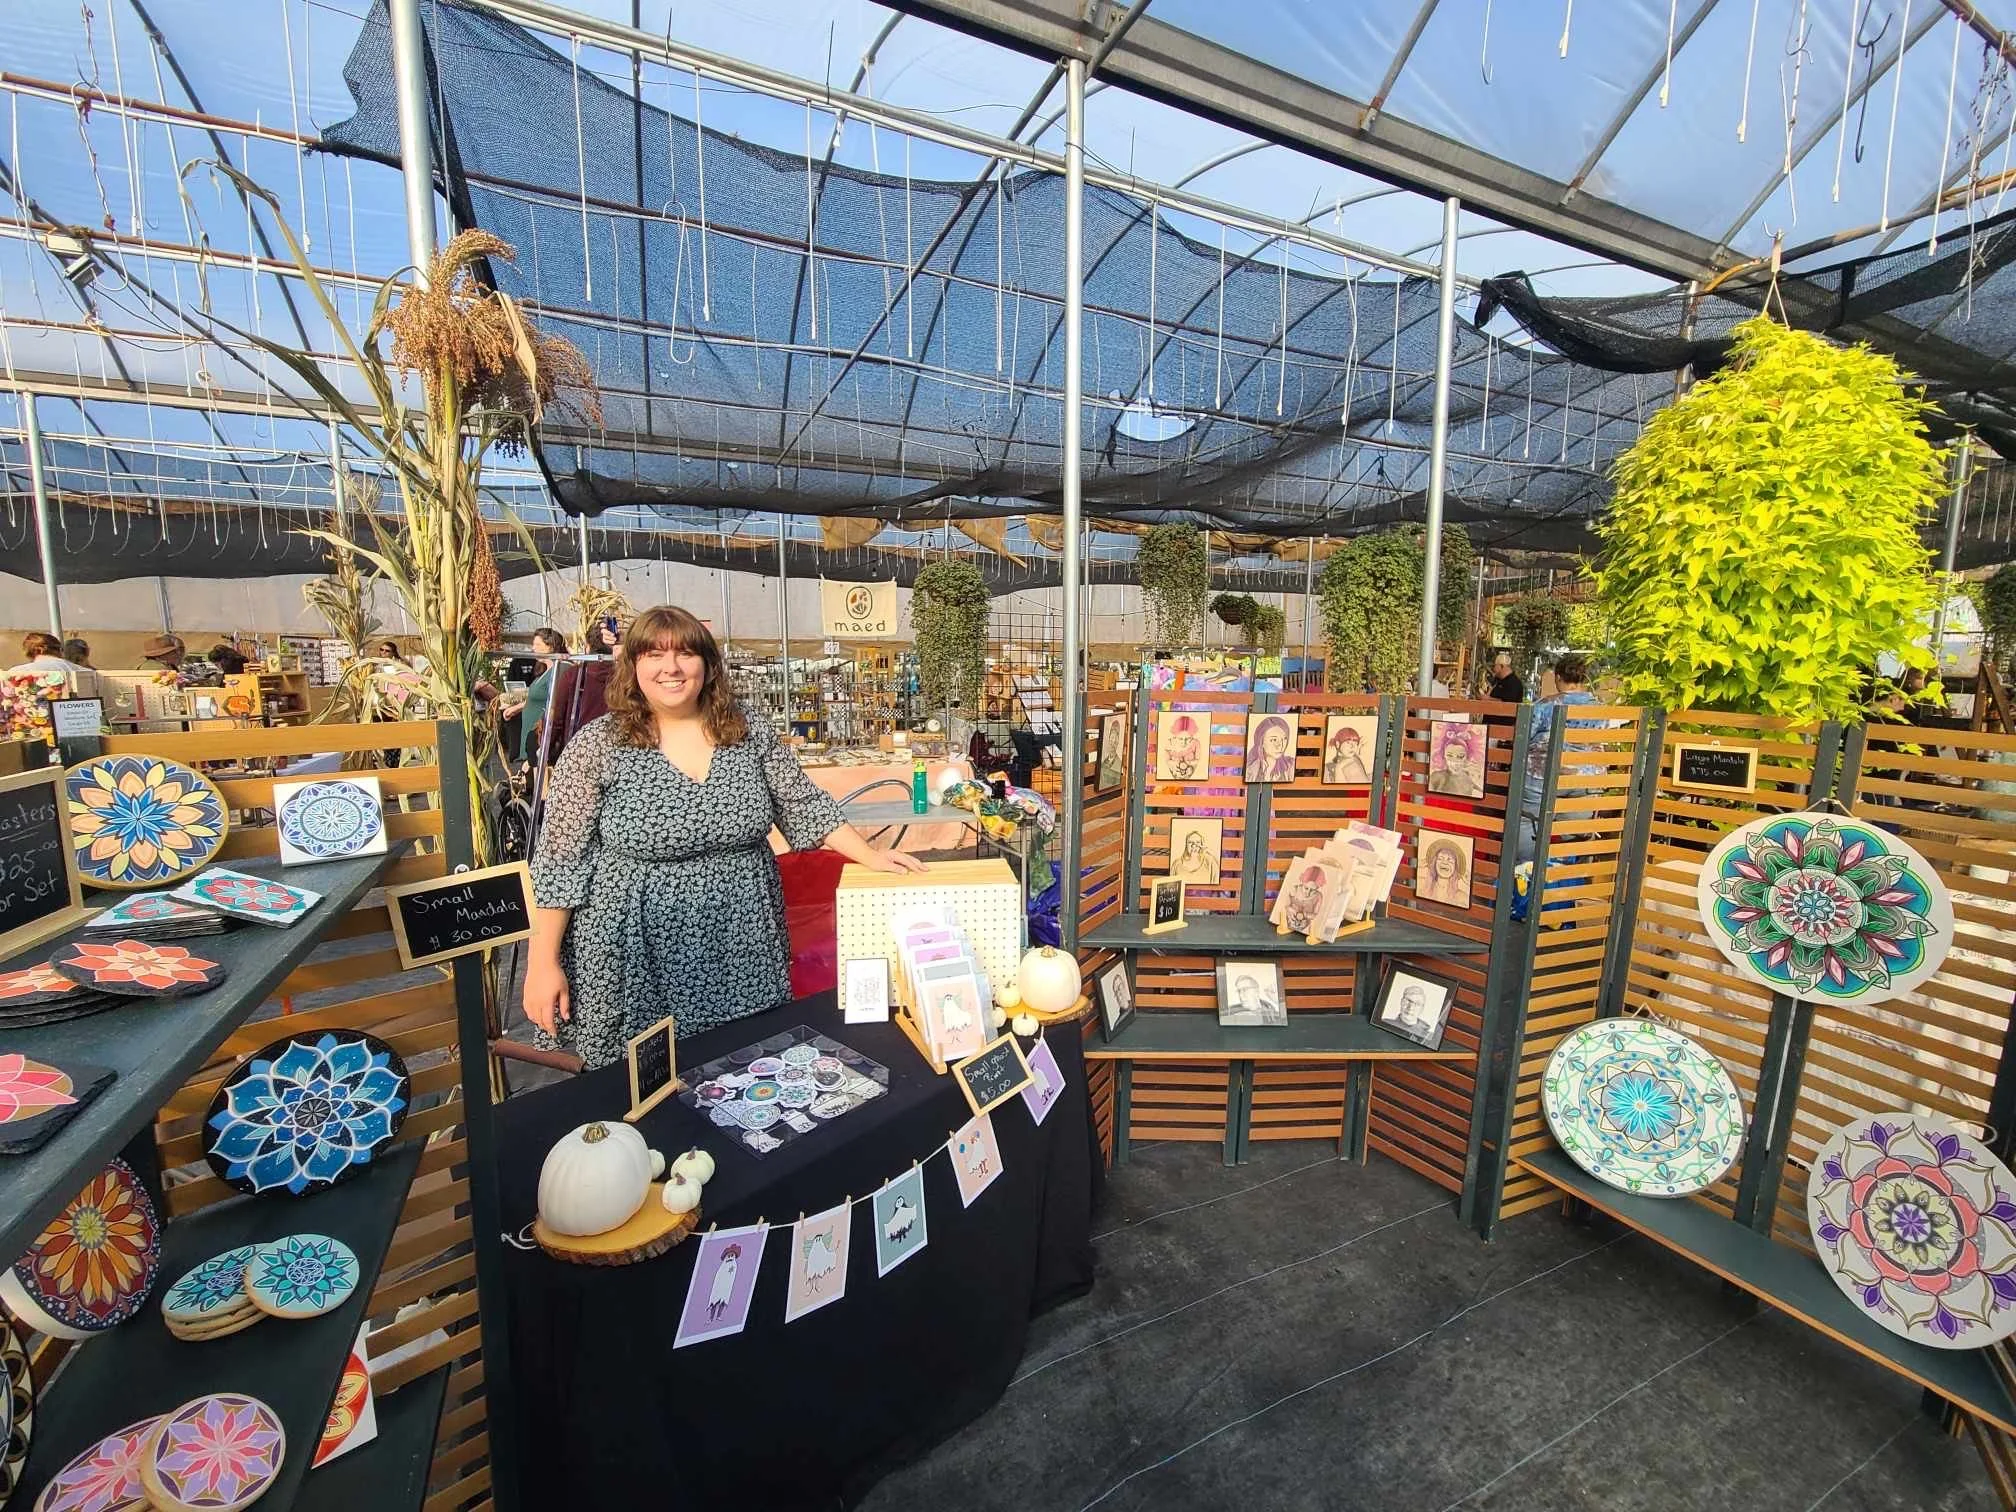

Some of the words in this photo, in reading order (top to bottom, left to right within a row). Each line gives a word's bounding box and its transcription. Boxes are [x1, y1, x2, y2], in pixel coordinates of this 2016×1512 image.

[834, 620, 886, 632] maed
[0, 803, 56, 831] asters
[0, 892, 16, 912] or
[24, 868, 59, 902] Set
[412, 886, 475, 914] Small
[456, 899, 521, 923] Mandala
[964, 1060, 991, 1083] Small
